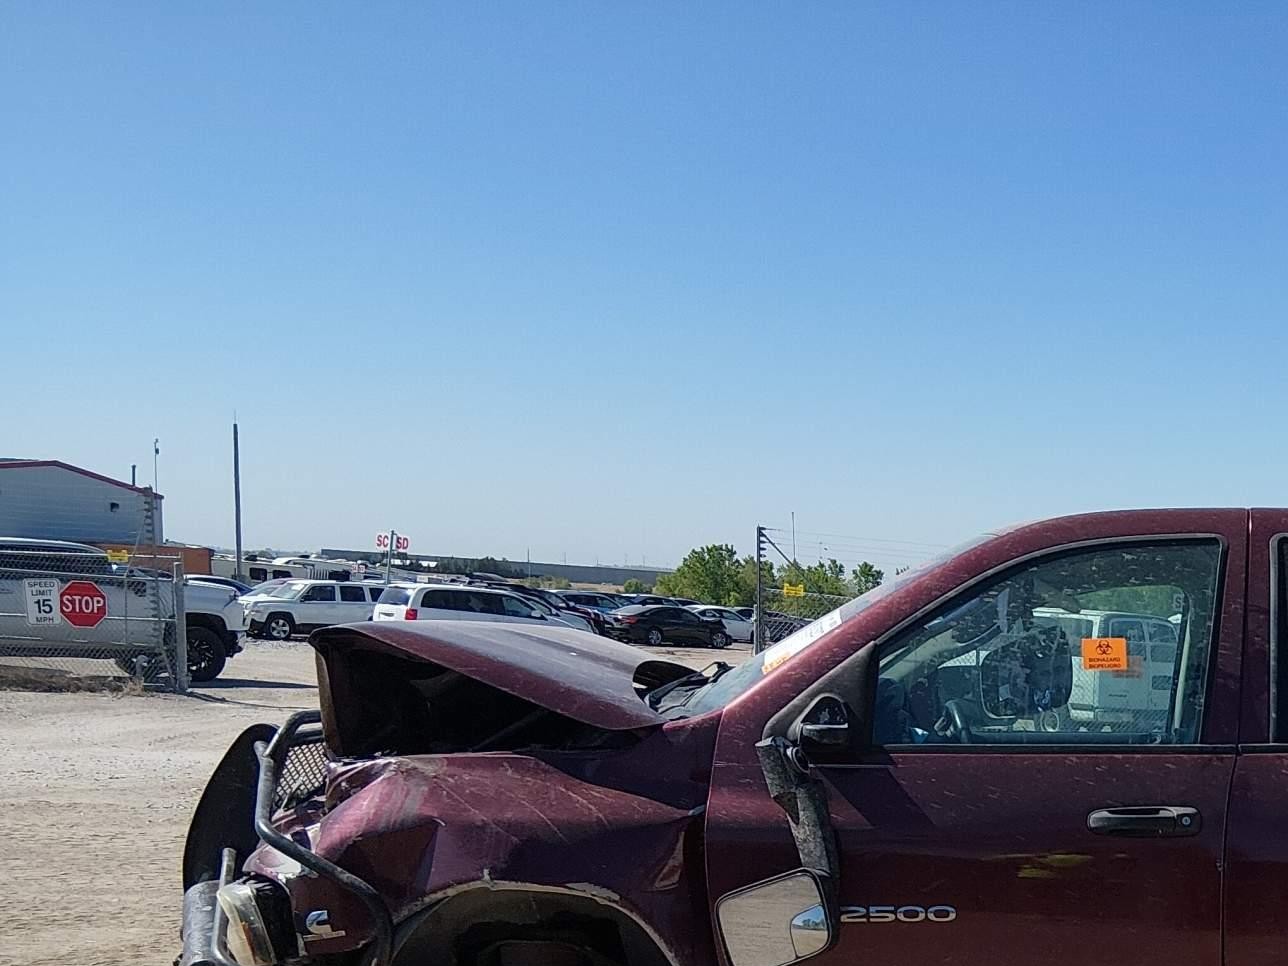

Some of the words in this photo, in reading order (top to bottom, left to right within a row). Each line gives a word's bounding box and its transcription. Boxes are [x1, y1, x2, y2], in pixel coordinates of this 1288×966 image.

[376, 534, 389, 548] SC
[395, 536, 409, 550] SD
[31, 589, 53, 597] LIMIT
[34, 598, 53, 614] 15
[62, 595, 104, 613] STOP
[839, 905, 957, 923] 2500
